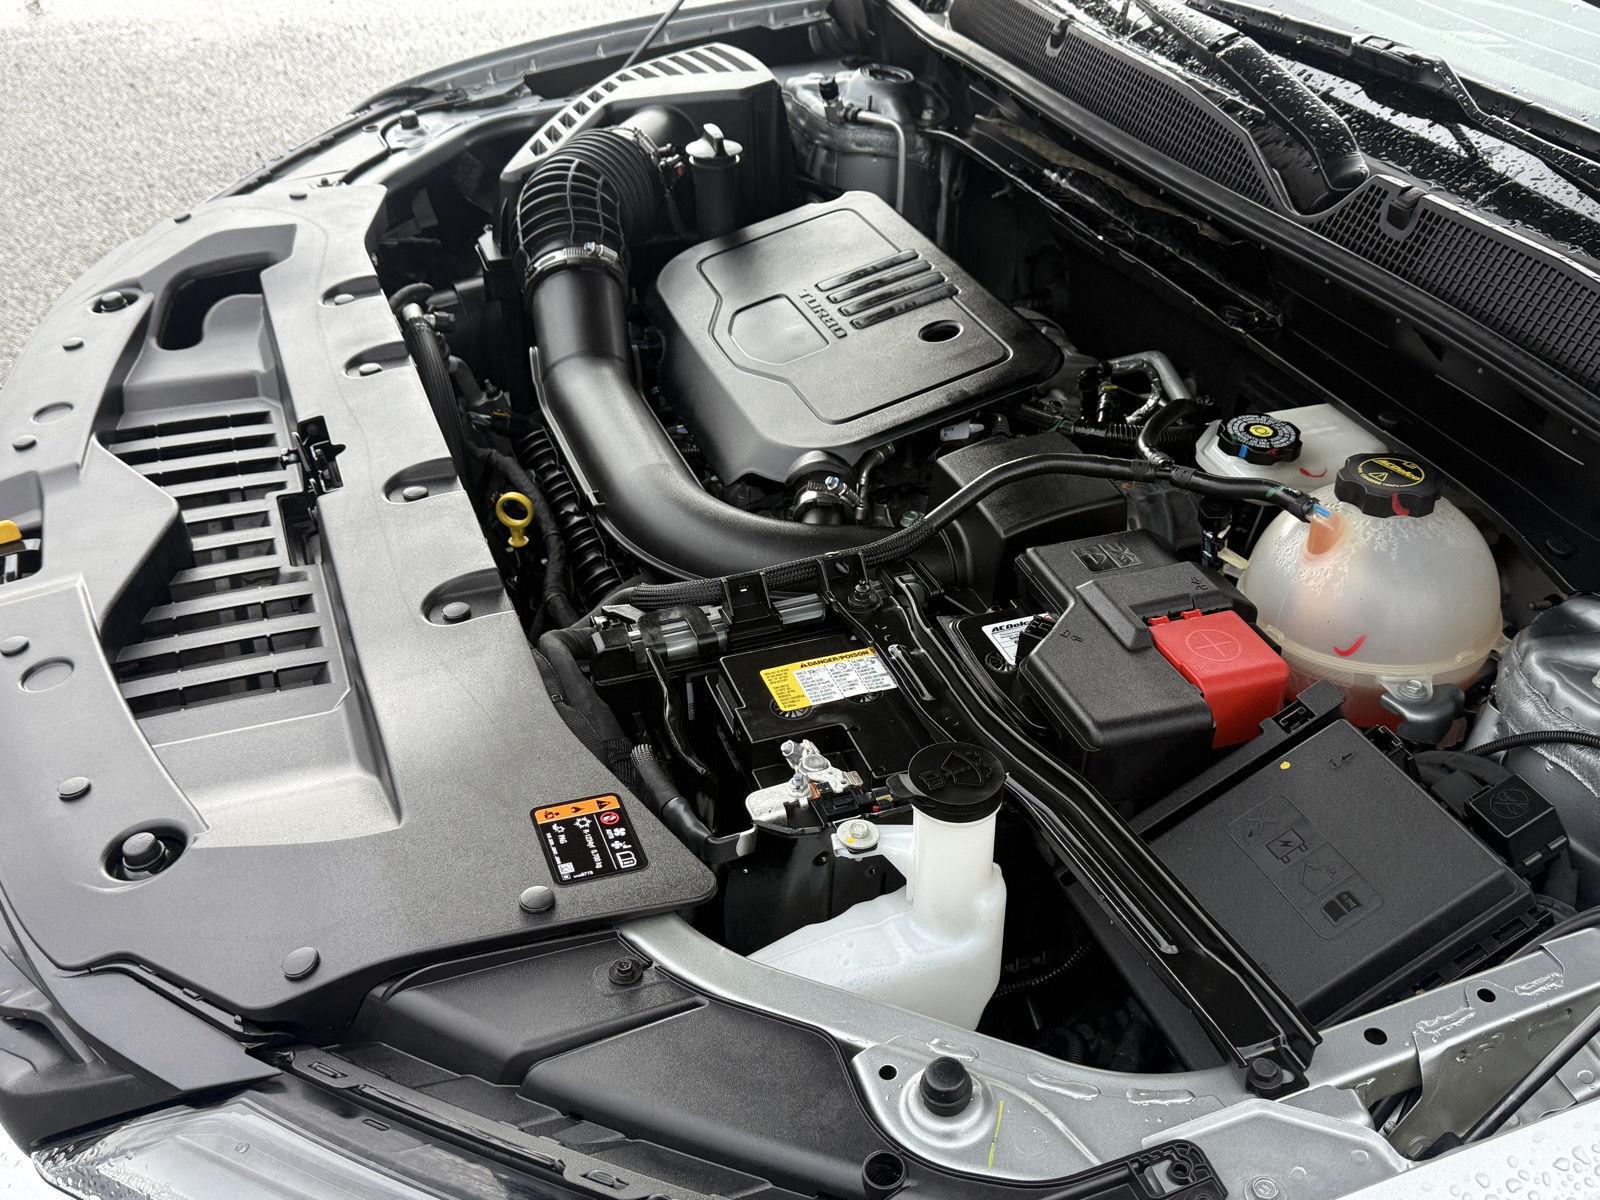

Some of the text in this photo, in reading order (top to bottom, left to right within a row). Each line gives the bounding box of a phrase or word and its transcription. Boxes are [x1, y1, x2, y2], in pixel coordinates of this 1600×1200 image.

[798, 289, 848, 339] TURBO
[807, 650, 869, 667] DANGER/POISON
[558, 834, 568, 845] PAG
